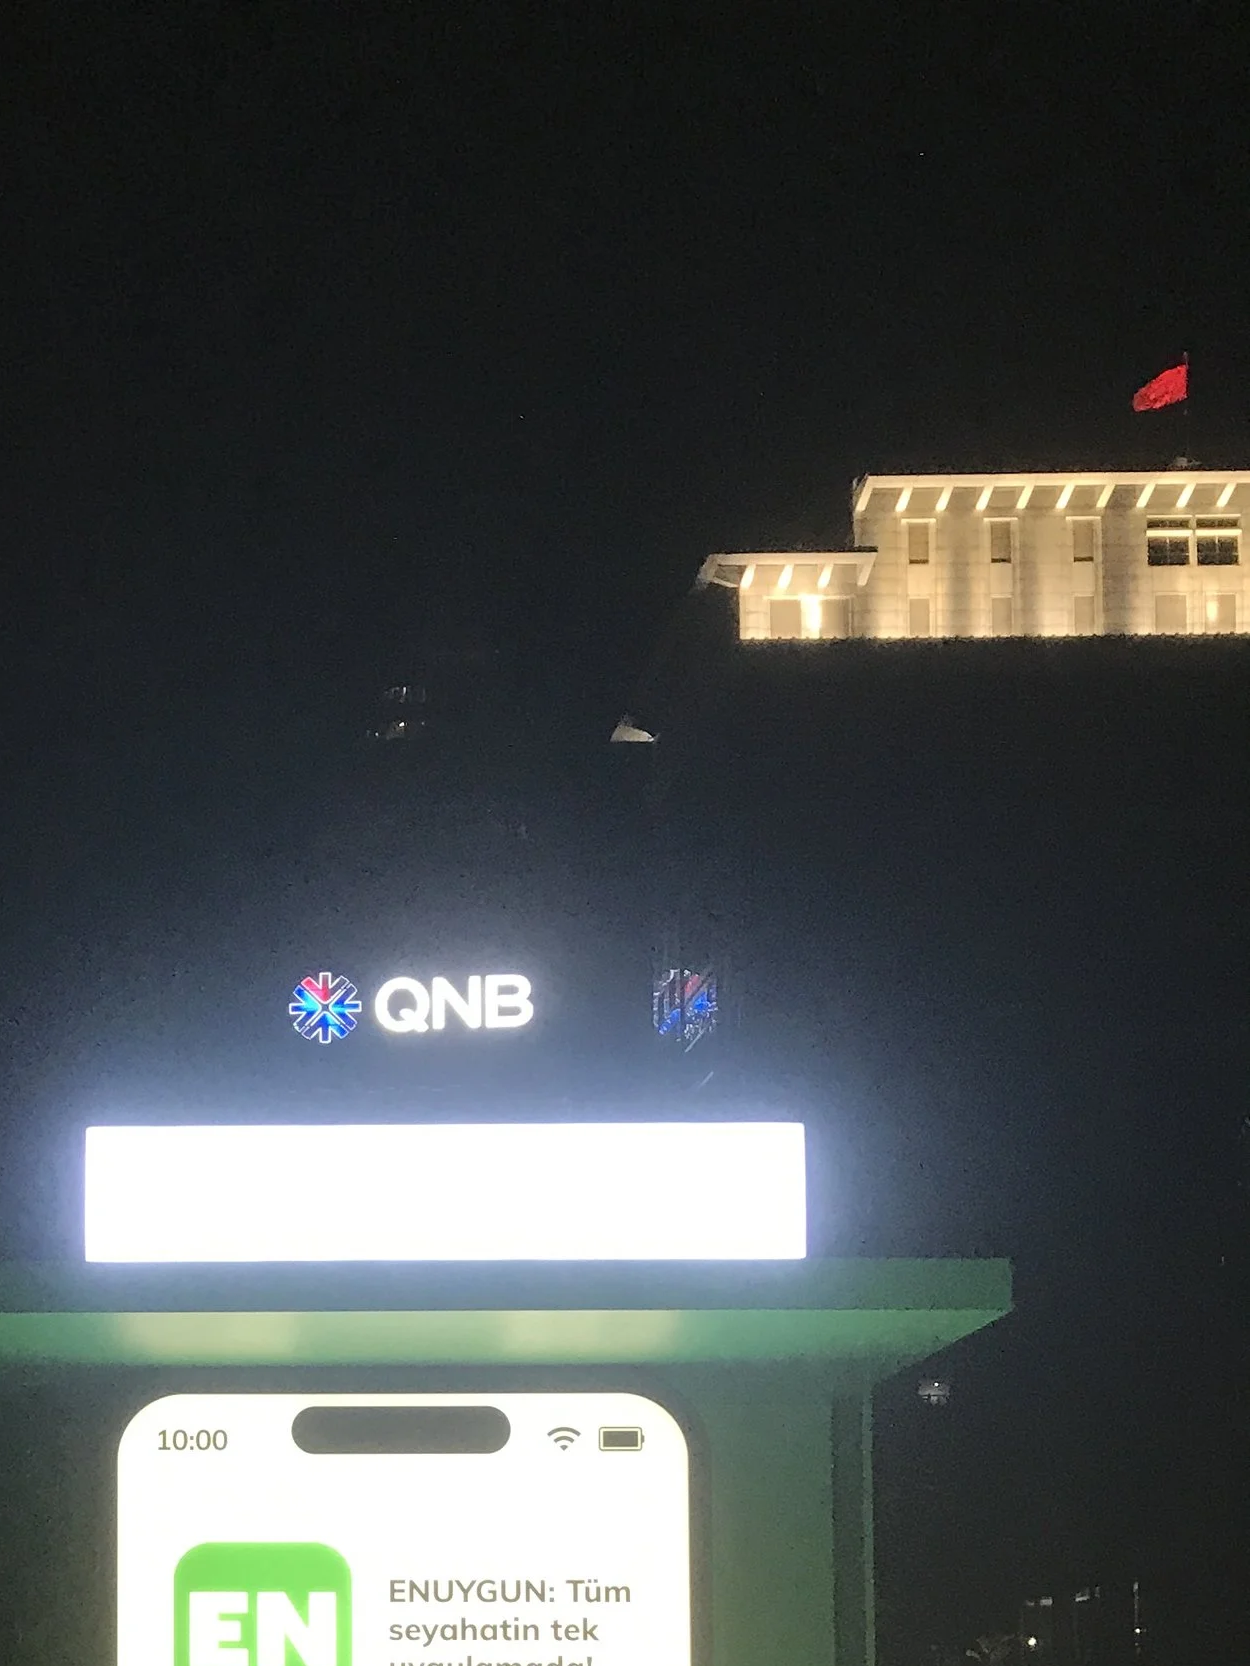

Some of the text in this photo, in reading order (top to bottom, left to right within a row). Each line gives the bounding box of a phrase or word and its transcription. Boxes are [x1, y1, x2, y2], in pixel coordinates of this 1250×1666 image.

[374, 973, 534, 1033] QNB
[157, 1429, 228, 1451] 10:00
[389, 1577, 631, 1603] ENUYGUN: Tüm
[389, 1617, 599, 1647] seyahatin tek
